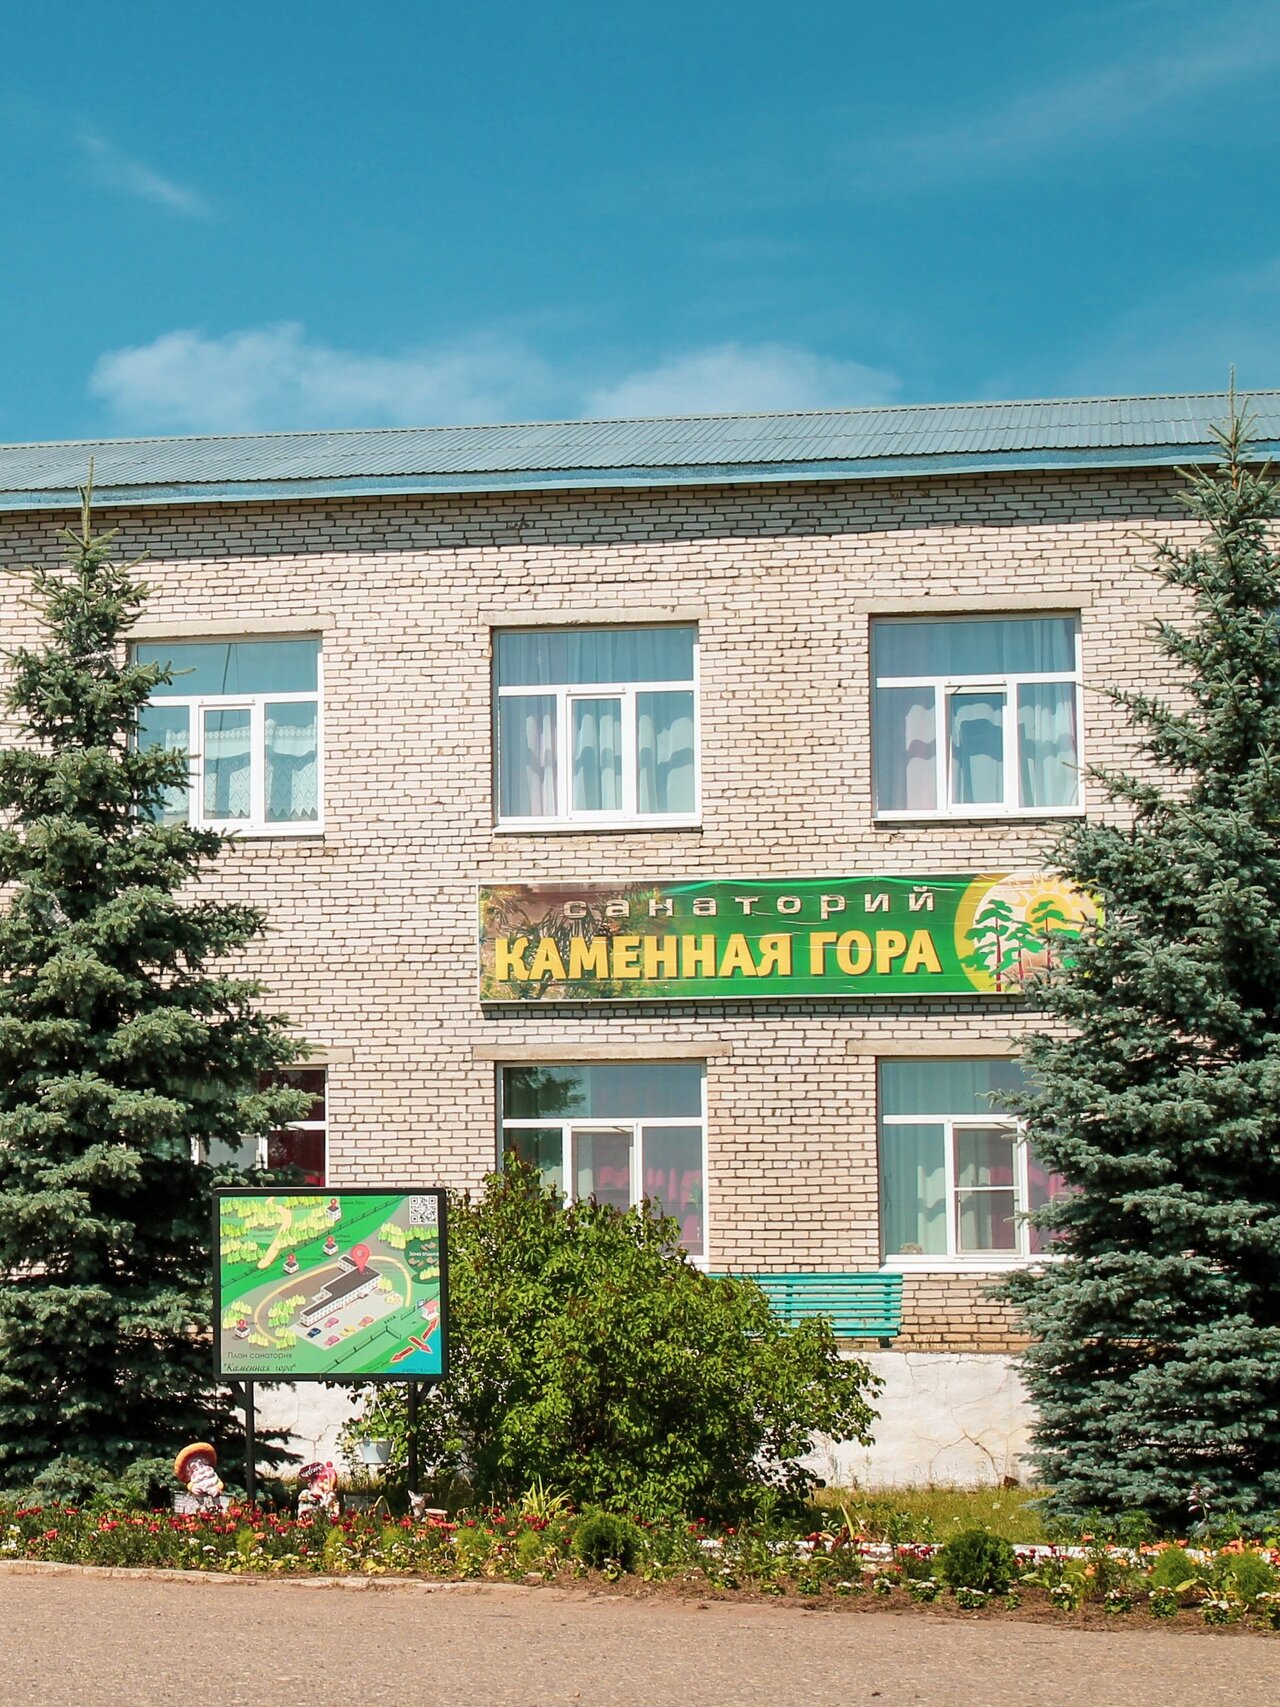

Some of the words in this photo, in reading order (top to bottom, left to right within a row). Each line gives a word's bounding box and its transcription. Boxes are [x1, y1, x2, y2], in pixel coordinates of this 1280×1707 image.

[563, 886, 934, 920] санаторий
[495, 931, 792, 982] КАМЕННАЯ
[809, 929, 943, 976] ГОРА
[227, 1351, 248, 1359] План
[249, 1352, 292, 1360] санатория
